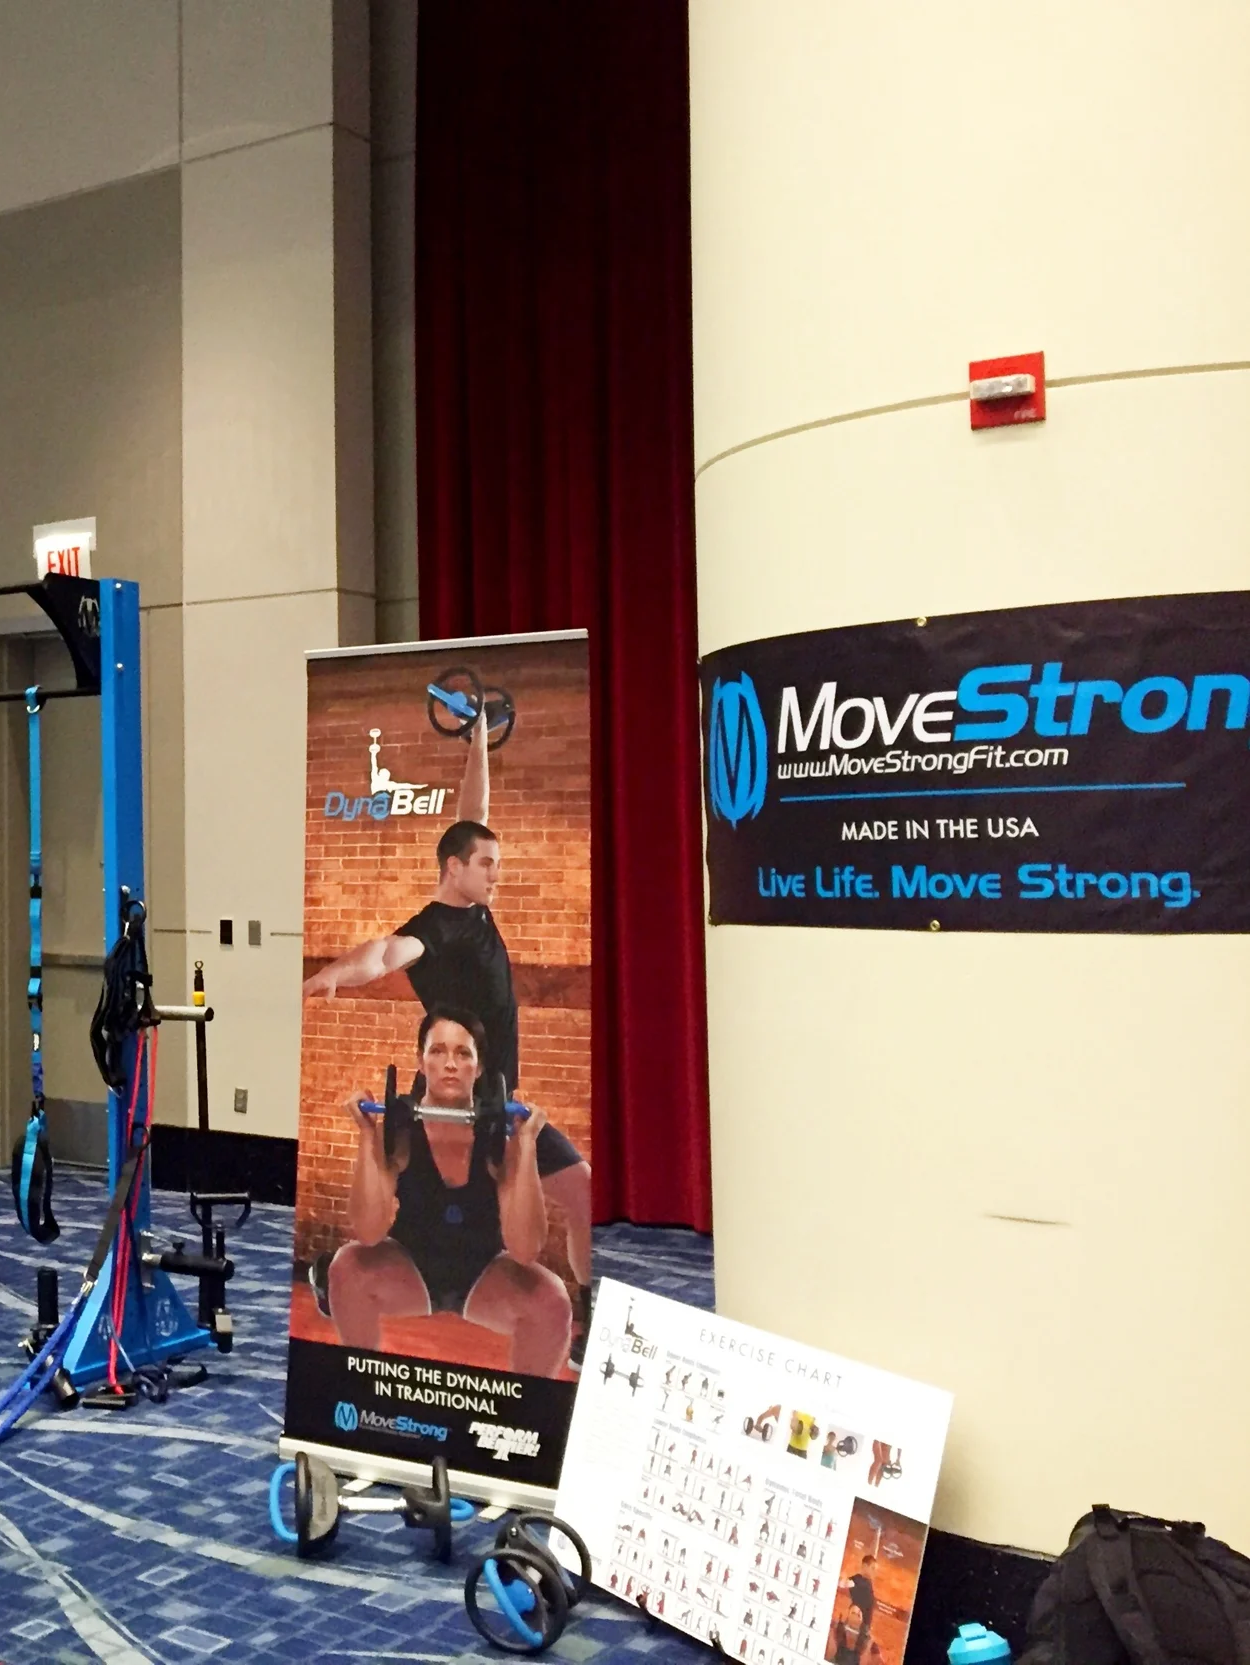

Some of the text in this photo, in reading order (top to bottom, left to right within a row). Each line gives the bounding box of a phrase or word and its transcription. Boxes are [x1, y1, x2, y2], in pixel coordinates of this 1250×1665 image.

[47, 546, 81, 578] EXIT
[777, 662, 1250, 753] MoveStron
[777, 745, 1070, 780] www.MoveStrongFit.com
[324, 788, 446, 822] DynaBell
[840, 816, 1040, 842] MADE IN THE USA
[758, 863, 1202, 908] Live Life. Move Strong.
[700, 1327, 776, 1367] EXERCISE
[784, 1358, 843, 1388] CHART
[347, 1356, 523, 1400] PUTTING THE DYNAMIC
[374, 1380, 498, 1416] IN TRADITIONAL
[359, 1409, 449, 1442] MoveStrong
